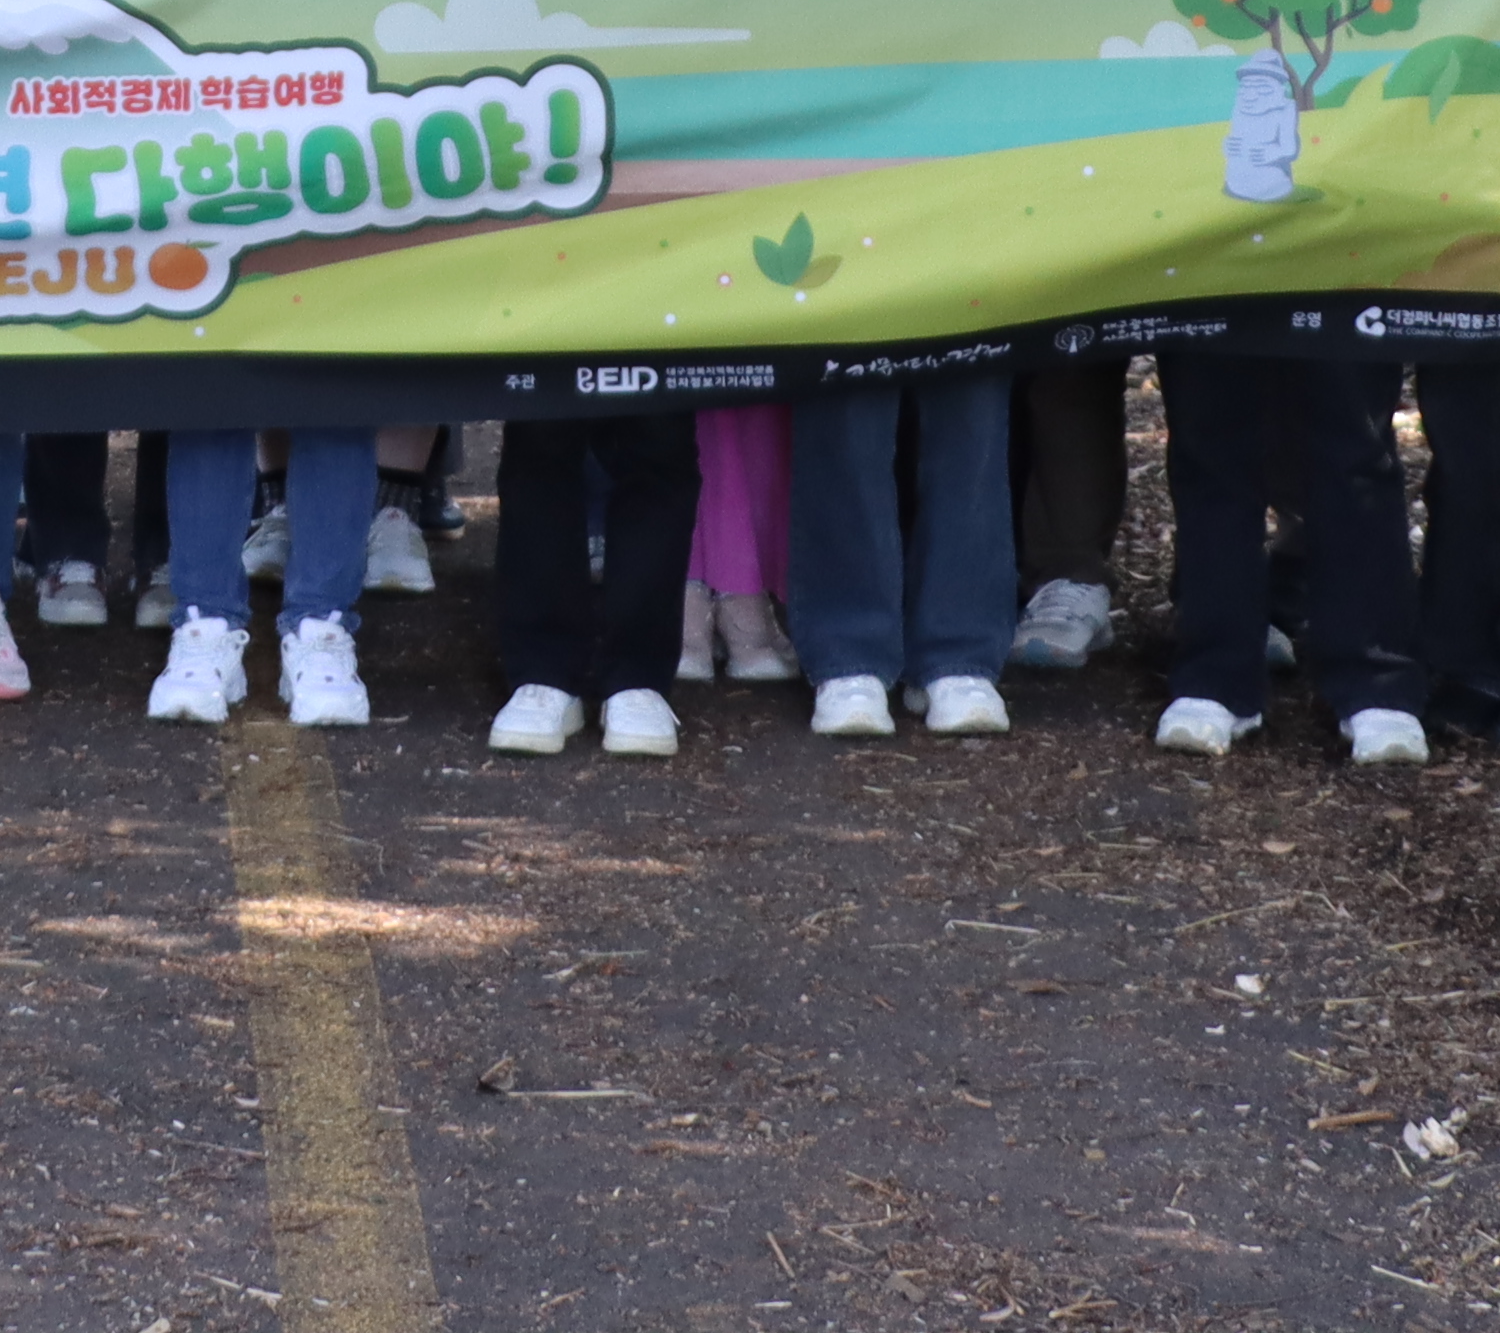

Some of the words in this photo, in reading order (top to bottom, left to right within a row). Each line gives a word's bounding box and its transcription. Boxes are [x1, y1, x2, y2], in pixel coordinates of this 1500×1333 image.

[10, 78, 191, 114] 사회적경제
[200, 71, 345, 110] 학습여행
[61, 89, 582, 236] 다행이야!
[1291, 311, 1322, 328] 운영
[505, 373, 536, 389] 주관
